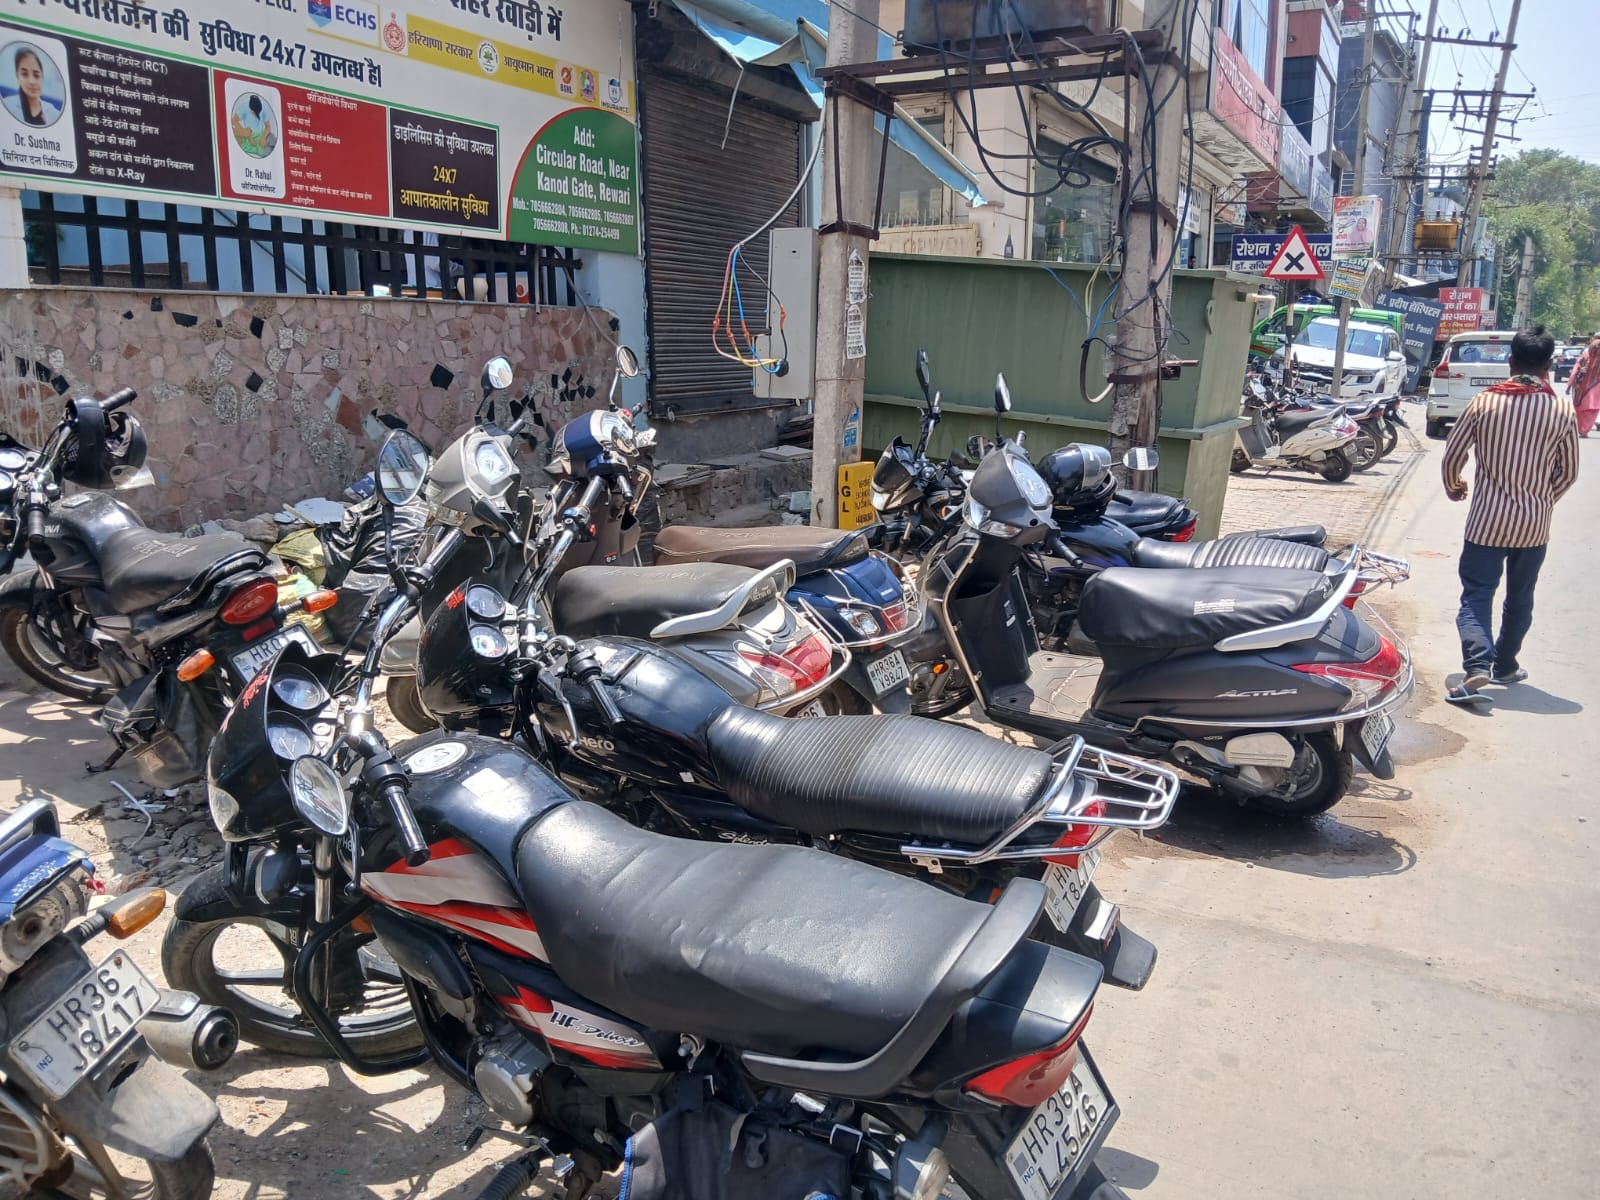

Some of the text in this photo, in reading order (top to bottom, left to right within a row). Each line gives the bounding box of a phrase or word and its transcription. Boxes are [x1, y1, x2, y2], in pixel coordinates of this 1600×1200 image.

[335, 5, 377, 31] ECHS
[547, 6, 562, 42] में
[161, 9, 190, 41] की
[199, 20, 255, 56] सुविधा
[259, 35, 306, 69] 24x7
[311, 50, 364, 82] उपलब्ध
[408, 31, 443, 51] हरियाणा
[445, 42, 473, 60] सरकार
[142, 60, 168, 75] (RCT)
[536, 65, 554, 80] भारत
[14, 132, 61, 152] Dr. Sushma
[393, 123, 494, 156] डाइलिसिस की सुविधा उपलब्ध
[574, 125, 595, 148] Add:
[245, 167, 272, 180] Dr. Rahul
[537, 143, 630, 180] Circular Road, Near
[117, 167, 145, 184] X-Ray
[537, 171, 631, 205] Kanod Gate, Rewari
[400, 189, 459, 212] आपातकालीन
[460, 193, 488, 219] सुविधा
[1236, 239, 1271, 256] रोशन
[1389, 297, 1409, 311] प्रदीप
[873, 653, 901, 677] HR36A
[879, 666, 904, 689] V9847
[47, 969, 120, 1041] HR36
[70, 985, 143, 1071] J8417
[550, 1011, 645, 1047] HF Deluxe
[37, 1054, 54, 1071] IND
[1022, 1071, 1083, 1164] HR36A
[1038, 1094, 1098, 1194] L4546
[1023, 1166, 1036, 1184] IND
